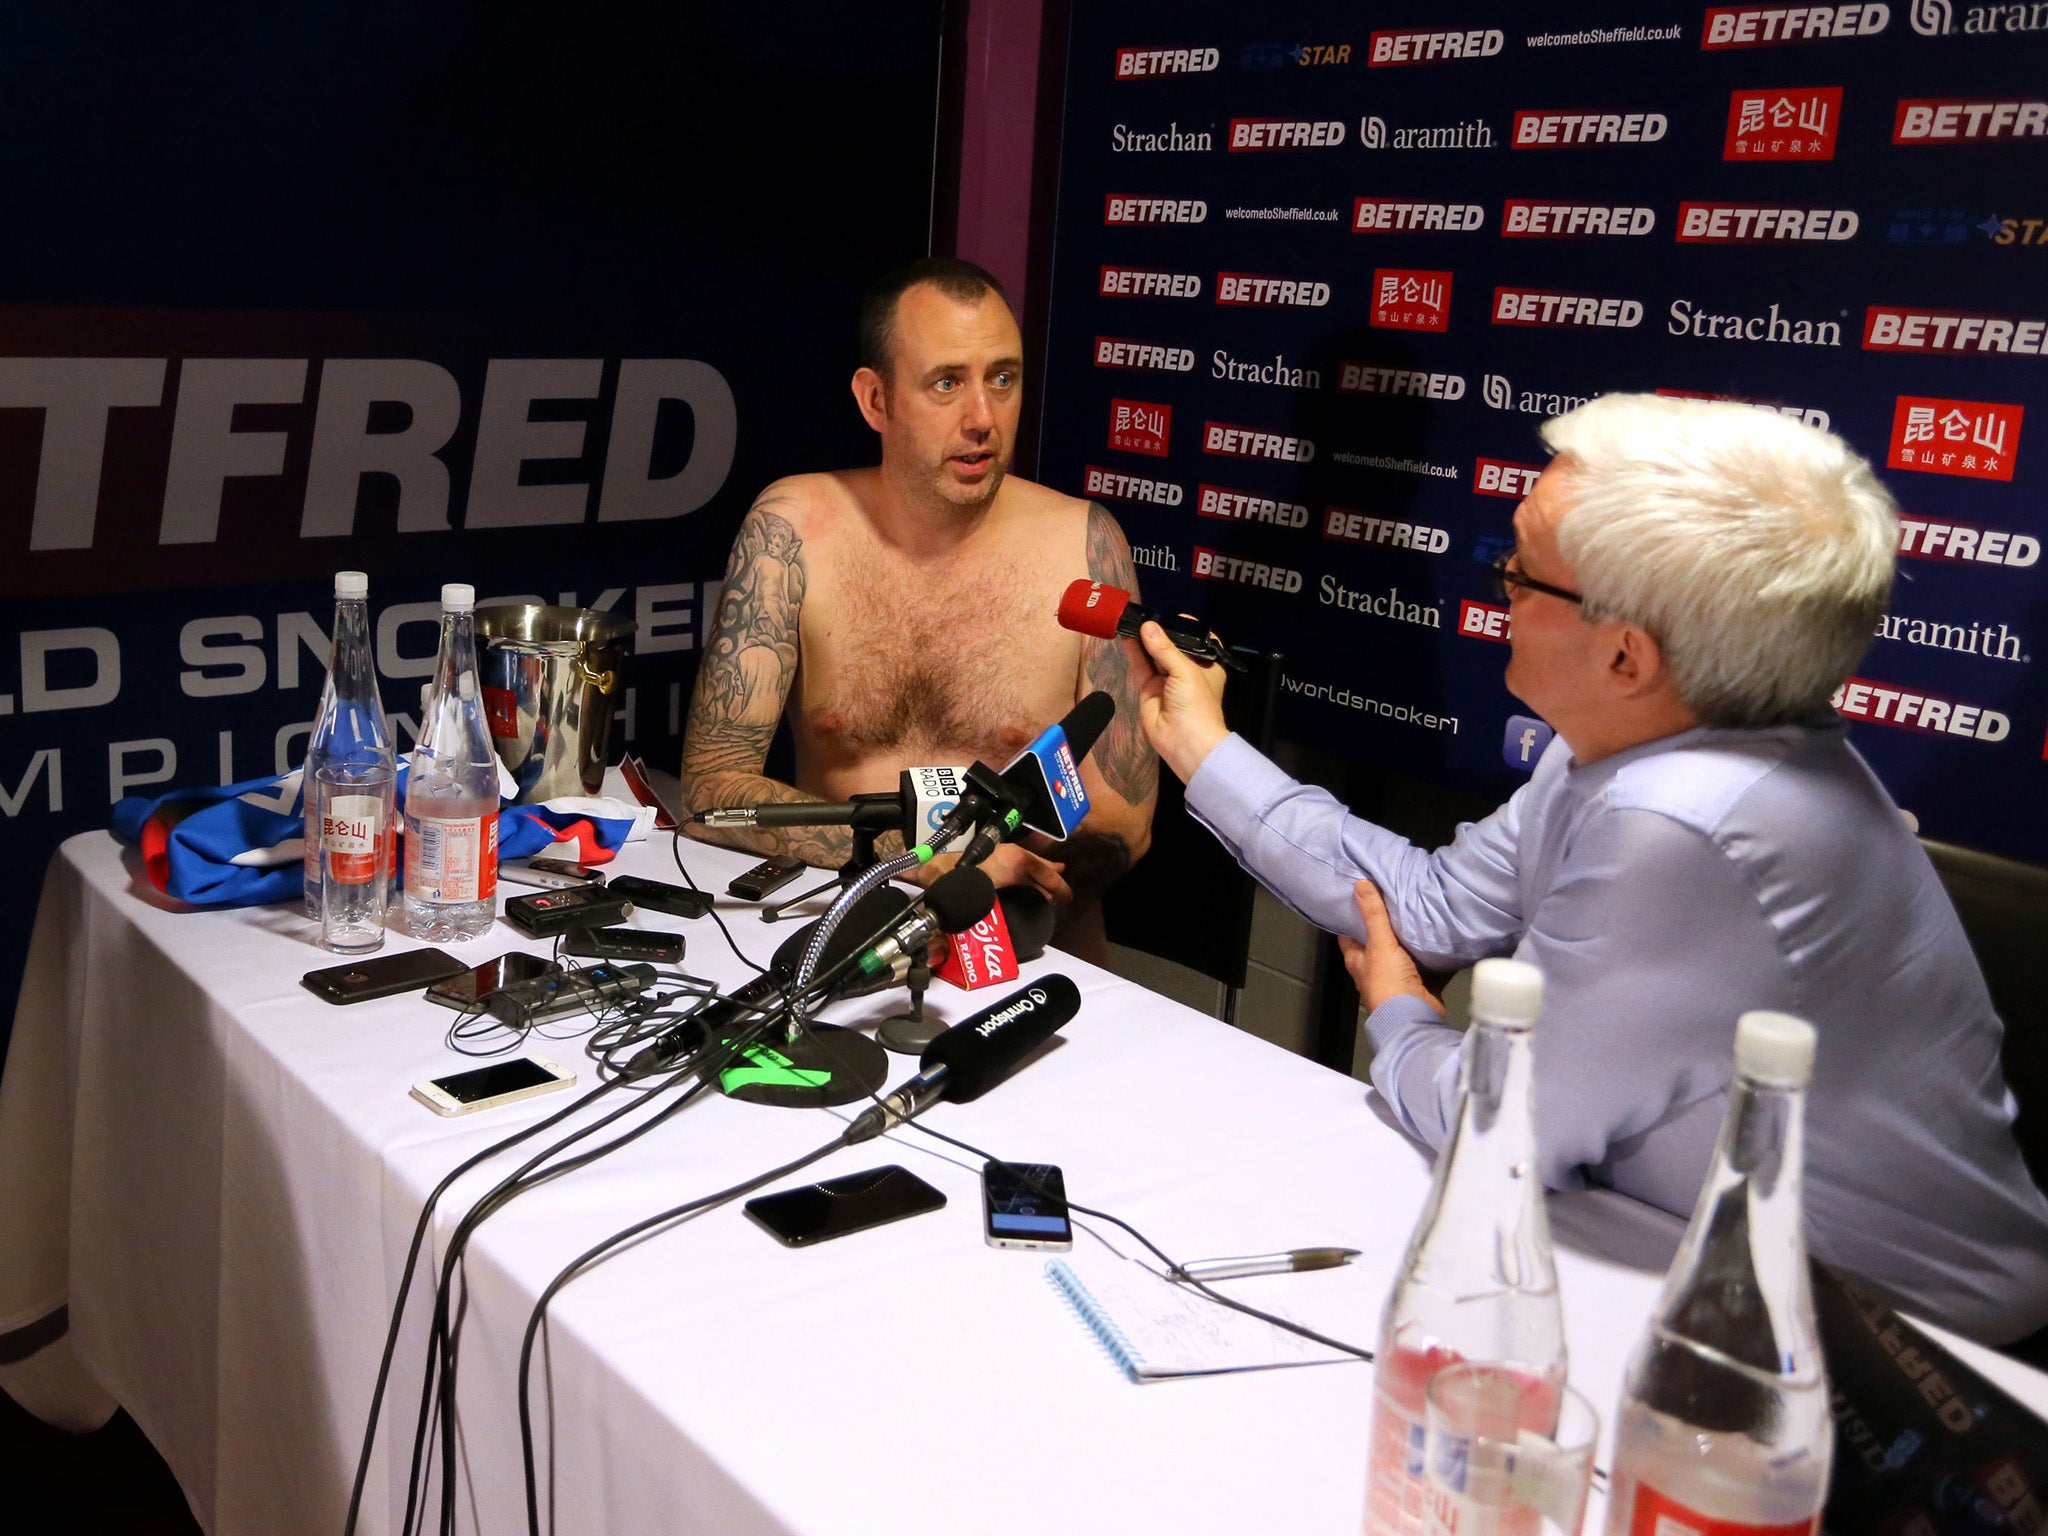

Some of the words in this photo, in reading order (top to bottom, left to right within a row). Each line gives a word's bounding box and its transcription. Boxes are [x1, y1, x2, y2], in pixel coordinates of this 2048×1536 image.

[1527, 25, 1681, 47] welcometoSheffield.co.uk
[1708, 4, 1889, 43] BETFRED
[1119, 48, 1219, 75] BETFRED
[1299, 45, 1351, 66] STAR
[1373, 30, 1504, 62] BETFRED
[1517, 114, 1667, 143] BETFRED
[1738, 98, 1827, 136] 昆仑山
[1900, 103, 2048, 138] BETFR
[1113, 122, 1211, 151] Strachan
[1233, 122, 1345, 147] BETFRED
[1394, 120, 1491, 148] aramith
[1736, 139, 1820, 153] 雪山矿泉水
[1108, 200, 1207, 223] BETFRED
[1226, 207, 1338, 220] welcometoSheffield.co.uk
[1357, 204, 1484, 230] BETFRED
[1507, 206, 1655, 235] BETFRED
[1682, 209, 1858, 240] BETFRED
[1103, 271, 1201, 297] BETFRED
[1220, 278, 1330, 306] BETFRED
[1380, 277, 1442, 311] 昆仑山
[1378, 311, 1438, 325] 雪山矿泉水
[1497, 294, 1643, 327] BETFRED
[1669, 300, 1840, 345] Strachan
[1869, 314, 2048, 355] BETFRE
[1098, 342, 1194, 371] BETFRED
[1212, 350, 1320, 390] Strachan
[1341, 366, 1465, 400] BETFRED
[1519, 392, 1599, 416] aram
[1116, 407, 1163, 438] 昆仑山
[1903, 406, 2006, 454] 昆仑山
[0, 357, 738, 552] TFRED
[1208, 427, 1315, 463] BETFRED
[1901, 448, 1998, 471] 雪山矿泉水
[1333, 451, 1458, 480] welcometoSheffield.co.uk
[1088, 471, 1182, 505] BETFRED
[1201, 490, 1307, 527] BETFRED
[1327, 511, 1450, 554] BETFRED
[1899, 520, 2040, 567] TFRED
[1132, 544, 1177, 571] mith
[1196, 552, 1302, 593] BETFRED
[1320, 575, 1440, 628] Strachan
[1874, 614, 2021, 662] aramith
[1281, 674, 1458, 734] worldsnooker1
[1829, 683, 2010, 742] BETFRED
[919, 768, 940, 798] RADIO
[937, 768, 960, 796] BBC
[1059, 745, 1085, 802] BETFRED
[324, 817, 366, 840] 昆仑山
[969, 908, 1004, 980] ójka
[959, 943, 978, 983] RADIO
[975, 998, 1035, 1038] Omnisport
